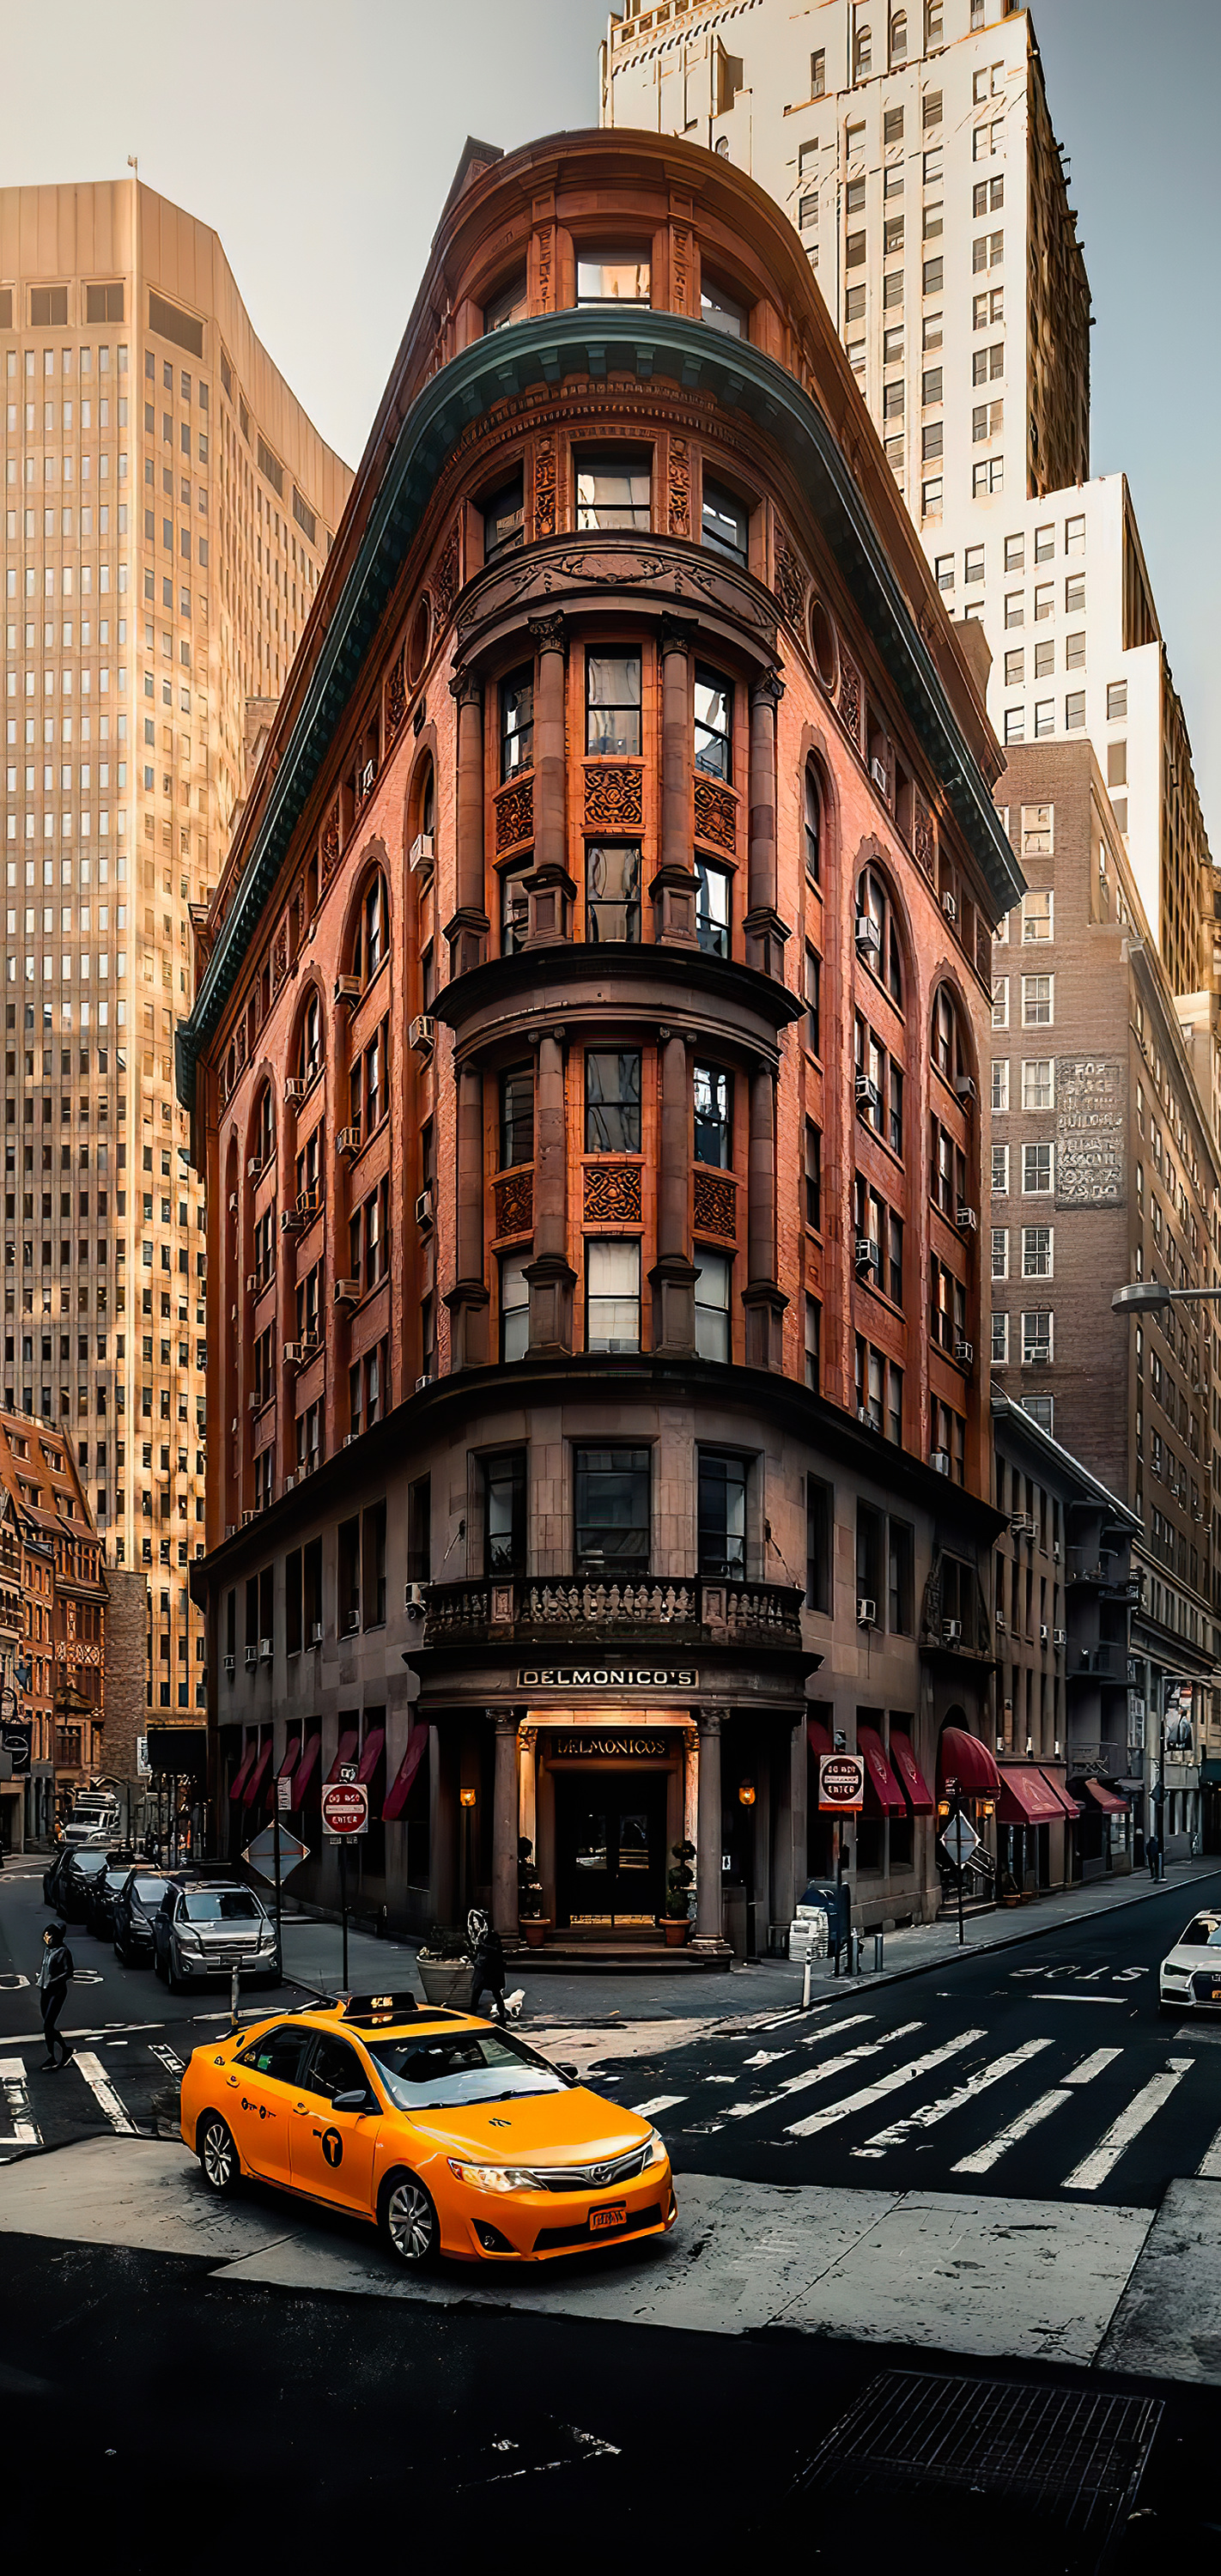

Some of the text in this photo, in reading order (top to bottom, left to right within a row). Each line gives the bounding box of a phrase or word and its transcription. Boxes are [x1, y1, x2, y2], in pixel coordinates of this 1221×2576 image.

[523, 1670, 692, 1685] DELMONICO'S
[828, 1785, 854, 1794] ENTER
[1009, 1965, 1150, 1981] STOP
